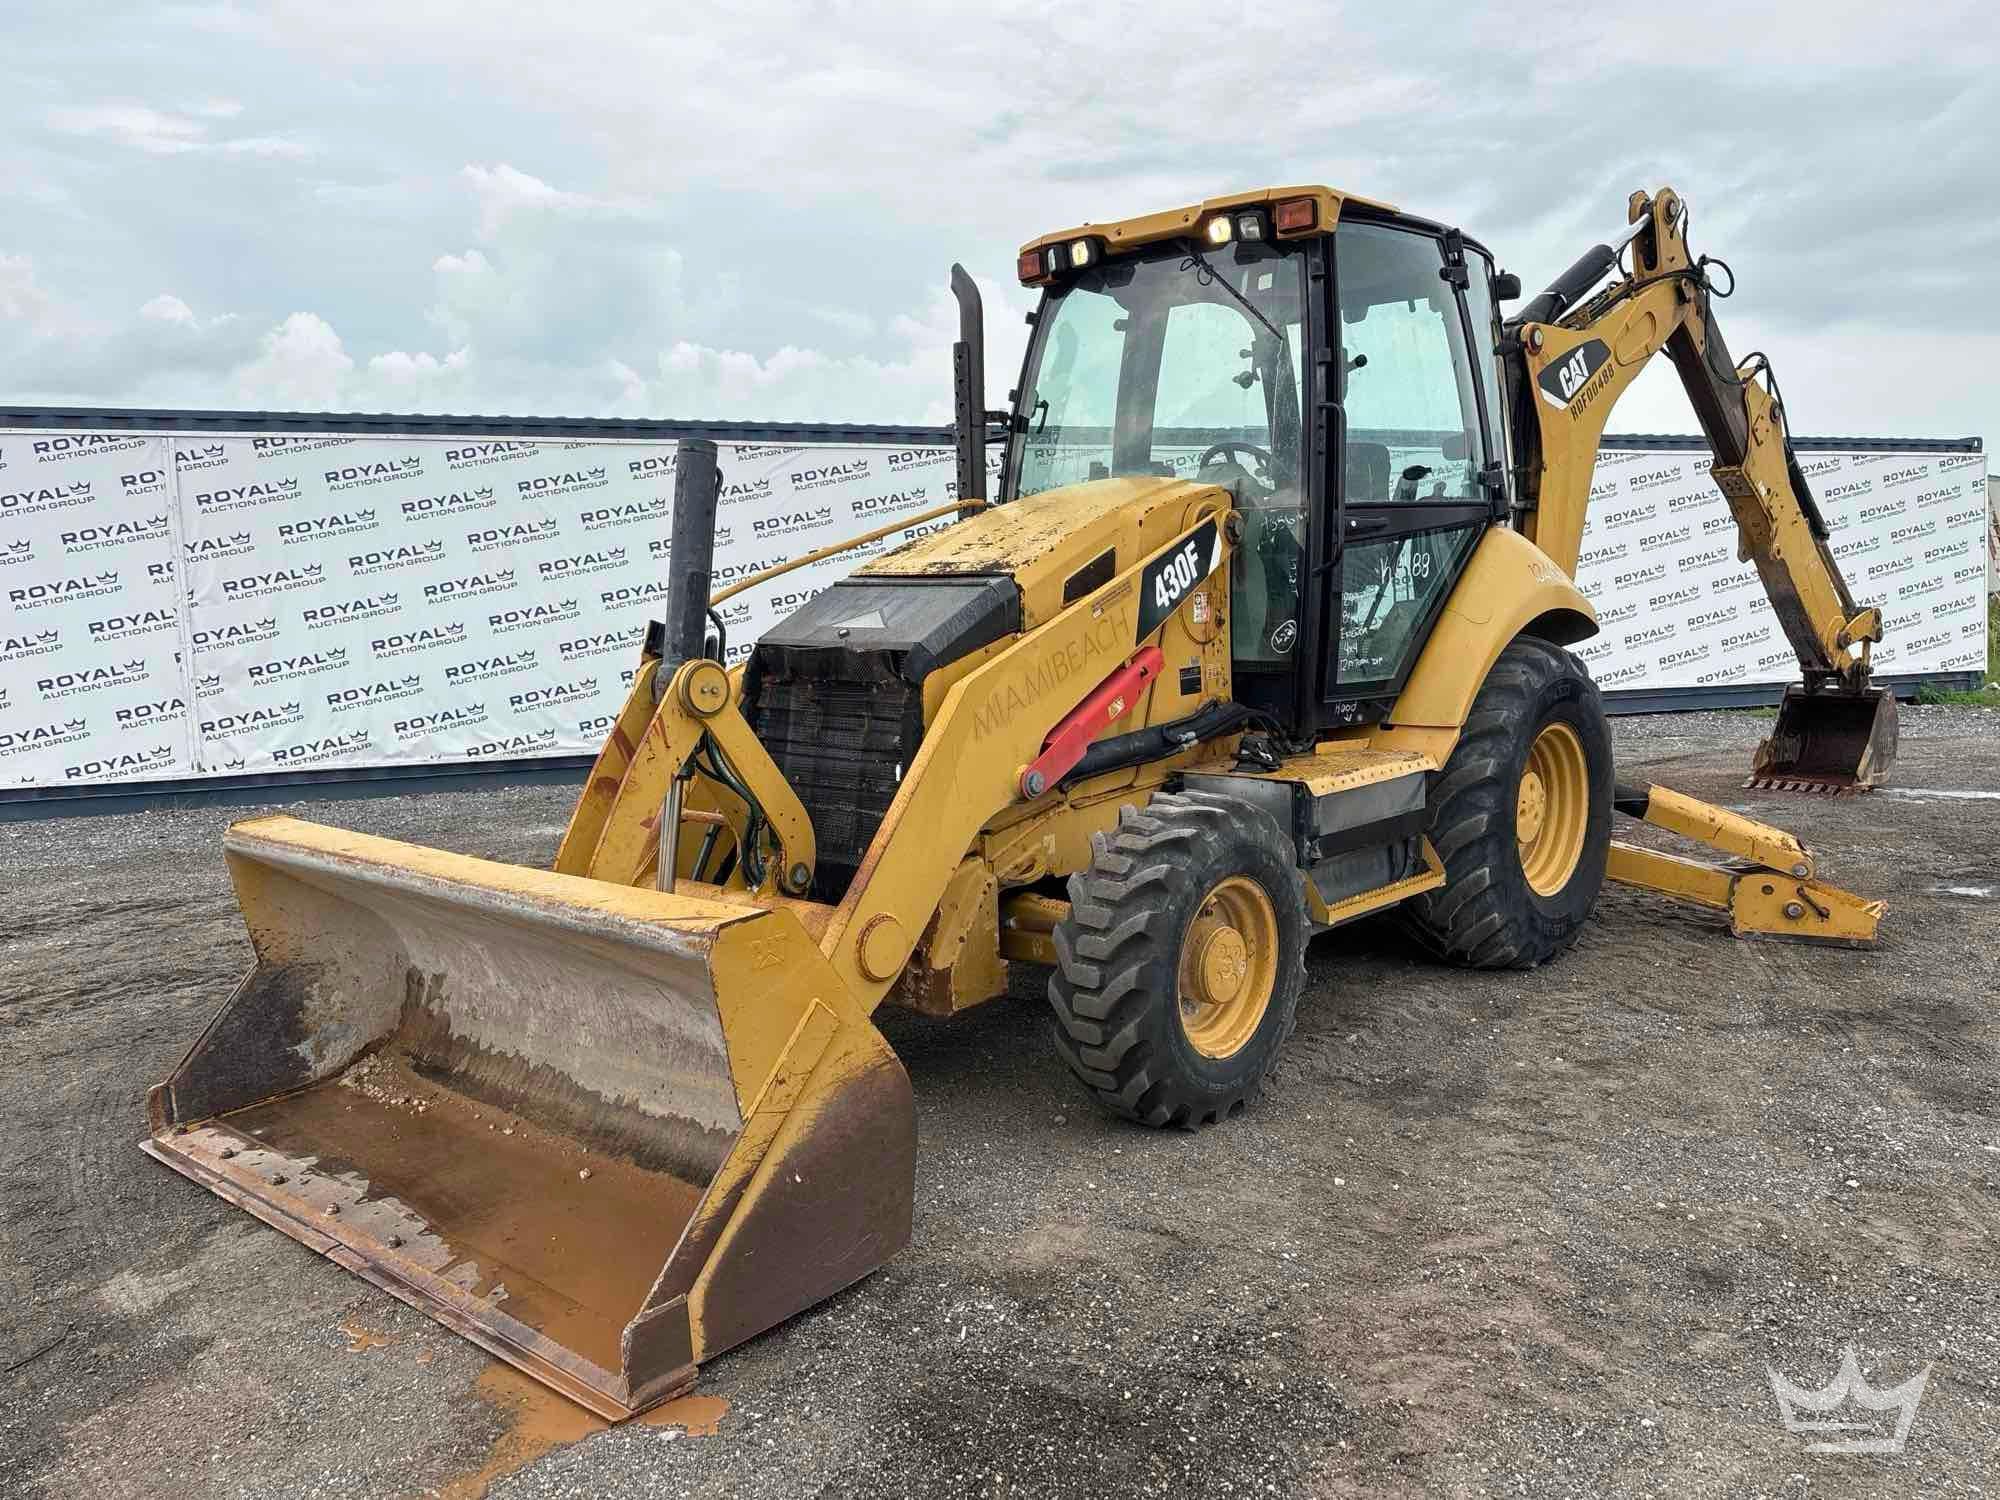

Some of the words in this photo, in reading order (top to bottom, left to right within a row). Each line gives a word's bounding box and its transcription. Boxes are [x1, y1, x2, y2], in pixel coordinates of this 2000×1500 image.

[1559, 347, 1590, 398] CAT
[38, 447, 97, 463] AUCTION
[99, 440, 147, 454] GROUP
[445, 441, 514, 462] ROYAL
[450, 454, 498, 470] AUCTION
[501, 446, 538, 462] GROUP
[738, 449, 781, 462] AUCTION
[184, 458, 229, 472] GROUP
[325, 460, 402, 483] ROYAL
[791, 464, 853, 484] ROYAL
[1883, 467, 1919, 483] ROYAL
[329, 476, 382, 492] AUCTION
[383, 468, 424, 484] GROUP
[518, 471, 589, 492] ROYAL
[795, 478, 836, 491] AUCTION
[837, 472, 870, 483] GROUP
[1630, 469, 1670, 486] ROYAL
[196, 481, 278, 506] ROYAL
[521, 486, 570, 501] AUCTION
[571, 480, 608, 493] GROUP
[739, 490, 773, 504] GROUP
[1669, 491, 1710, 508] ROYAL
[1825, 481, 1862, 498] ROYAL
[1917, 488, 1952, 504] ROYAL
[49, 495, 96, 510] GROUP
[200, 497, 257, 514] AUCTION
[258, 491, 302, 504] GROUP
[401, 492, 472, 514] ROYAL
[404, 506, 455, 522] AUCTION
[457, 500, 496, 512] GROUP
[852, 491, 912, 511] ROYAL
[854, 503, 895, 519] AUCTION
[897, 498, 928, 510] GROUP
[1860, 502, 1896, 519] ROYAL
[581, 502, 650, 524] ROYAL
[584, 517, 631, 532] AUCTION
[633, 509, 669, 522] GROUP
[753, 511, 817, 532] ROYAL
[1605, 507, 1646, 524] ROYAL
[60, 520, 148, 545] ROYAL
[278, 512, 357, 537] ROYAL
[282, 527, 337, 545] AUCTION
[338, 521, 384, 535] GROUP
[467, 522, 539, 544] ROYAL
[756, 524, 799, 540] AUCTION
[801, 519, 834, 530] GROUP
[1891, 523, 1926, 540] ROYAL
[66, 534, 125, 554] AUCTION
[471, 538, 520, 552] AUCTION
[522, 531, 560, 544] GROUP
[1640, 530, 1680, 546] ROYAL
[1833, 539, 1870, 555] ROYAL
[212, 545, 255, 559] GROUP
[348, 544, 424, 568] ROYAL
[812, 555, 852, 568] AUCTION
[854, 546, 887, 559] GROUP
[1678, 550, 1718, 568] ROYAL
[1924, 543, 1959, 559] ROYAL
[353, 559, 404, 576] AUCTION
[406, 553, 448, 565] GROUP
[539, 551, 609, 574] ROYAL
[543, 566, 590, 583] AUCTION
[592, 560, 629, 572] GROUP
[1868, 560, 1904, 575] ROYAL
[222, 568, 305, 593] ROYAL
[424, 573, 497, 597] ROYAL
[1154, 540, 1201, 608] 430F
[1615, 568, 1654, 584] ROYAL
[1712, 572, 1750, 589] ROYAL
[9, 576, 100, 602] ROYAL
[226, 585, 282, 602] AUCTION
[285, 577, 326, 592] GROUP
[428, 590, 477, 605] AUCTION
[479, 581, 520, 594] GROUP
[601, 582, 668, 604] ROYAL
[1649, 589, 1689, 606] ROYAL
[1899, 578, 1934, 595] ROYAL
[14, 594, 73, 613] AUCTION
[76, 585, 123, 601] GROUP
[303, 597, 381, 622] ROYAL
[605, 596, 651, 611] AUCTION
[1932, 598, 1966, 613] ROYAL
[88, 607, 174, 634] ROYAL
[307, 614, 360, 630] AUCTION
[362, 606, 402, 621] GROUP
[489, 604, 559, 626] ROYAL
[493, 619, 542, 635] AUCTION
[543, 611, 584, 624] GROUP
[1688, 609, 1726, 627] ROYAL
[94, 626, 152, 643] AUCTION
[237, 631, 280, 645] GROUP
[371, 626, 446, 651] ROYAL
[560, 630, 629, 653] ROYAL
[1625, 627, 1664, 644] ROYAL
[1721, 630, 1760, 647] ROYAL
[1906, 633, 1941, 650] ROYAL
[16, 644, 64, 658] GROUP
[375, 642, 426, 659] AUCTION
[428, 635, 472, 648] GROUP
[563, 647, 610, 662] AUCTION
[1659, 647, 1698, 665] ROYAL
[248, 652, 327, 678] ROYAL
[253, 669, 307, 687] AUCTION
[308, 661, 349, 674] GROUP
[445, 654, 518, 679] ROYAL
[448, 670, 498, 688] AUCTION
[500, 662, 539, 676] GROUP
[1697, 666, 1736, 684] ROYAL
[37, 664, 125, 691] ROYAL
[42, 683, 102, 701] AUCTION
[104, 673, 150, 688] GROUP
[327, 680, 403, 705] ROYAL
[332, 697, 382, 712] AUCTION
[384, 688, 424, 703] GROUP
[509, 681, 580, 706] ROYAL
[513, 698, 561, 714] AUCTION
[562, 690, 600, 703] GROUP
[120, 715, 164, 730] AUCTION
[200, 706, 283, 734] ROYAL
[204, 724, 260, 742] AUCTION
[263, 715, 304, 730] GROUP
[394, 707, 467, 733] ROYAL
[398, 724, 447, 743] AUCTION
[449, 716, 488, 729] GROUP
[43, 732, 91, 746] GROUP
[272, 734, 350, 762] ROYAL
[466, 733, 538, 759] ROYAL
[520, 740, 562, 756] GROUP
[331, 742, 377, 759] GROUP
[65, 750, 152, 779] ROYAL
[131, 759, 176, 778] GROUP
